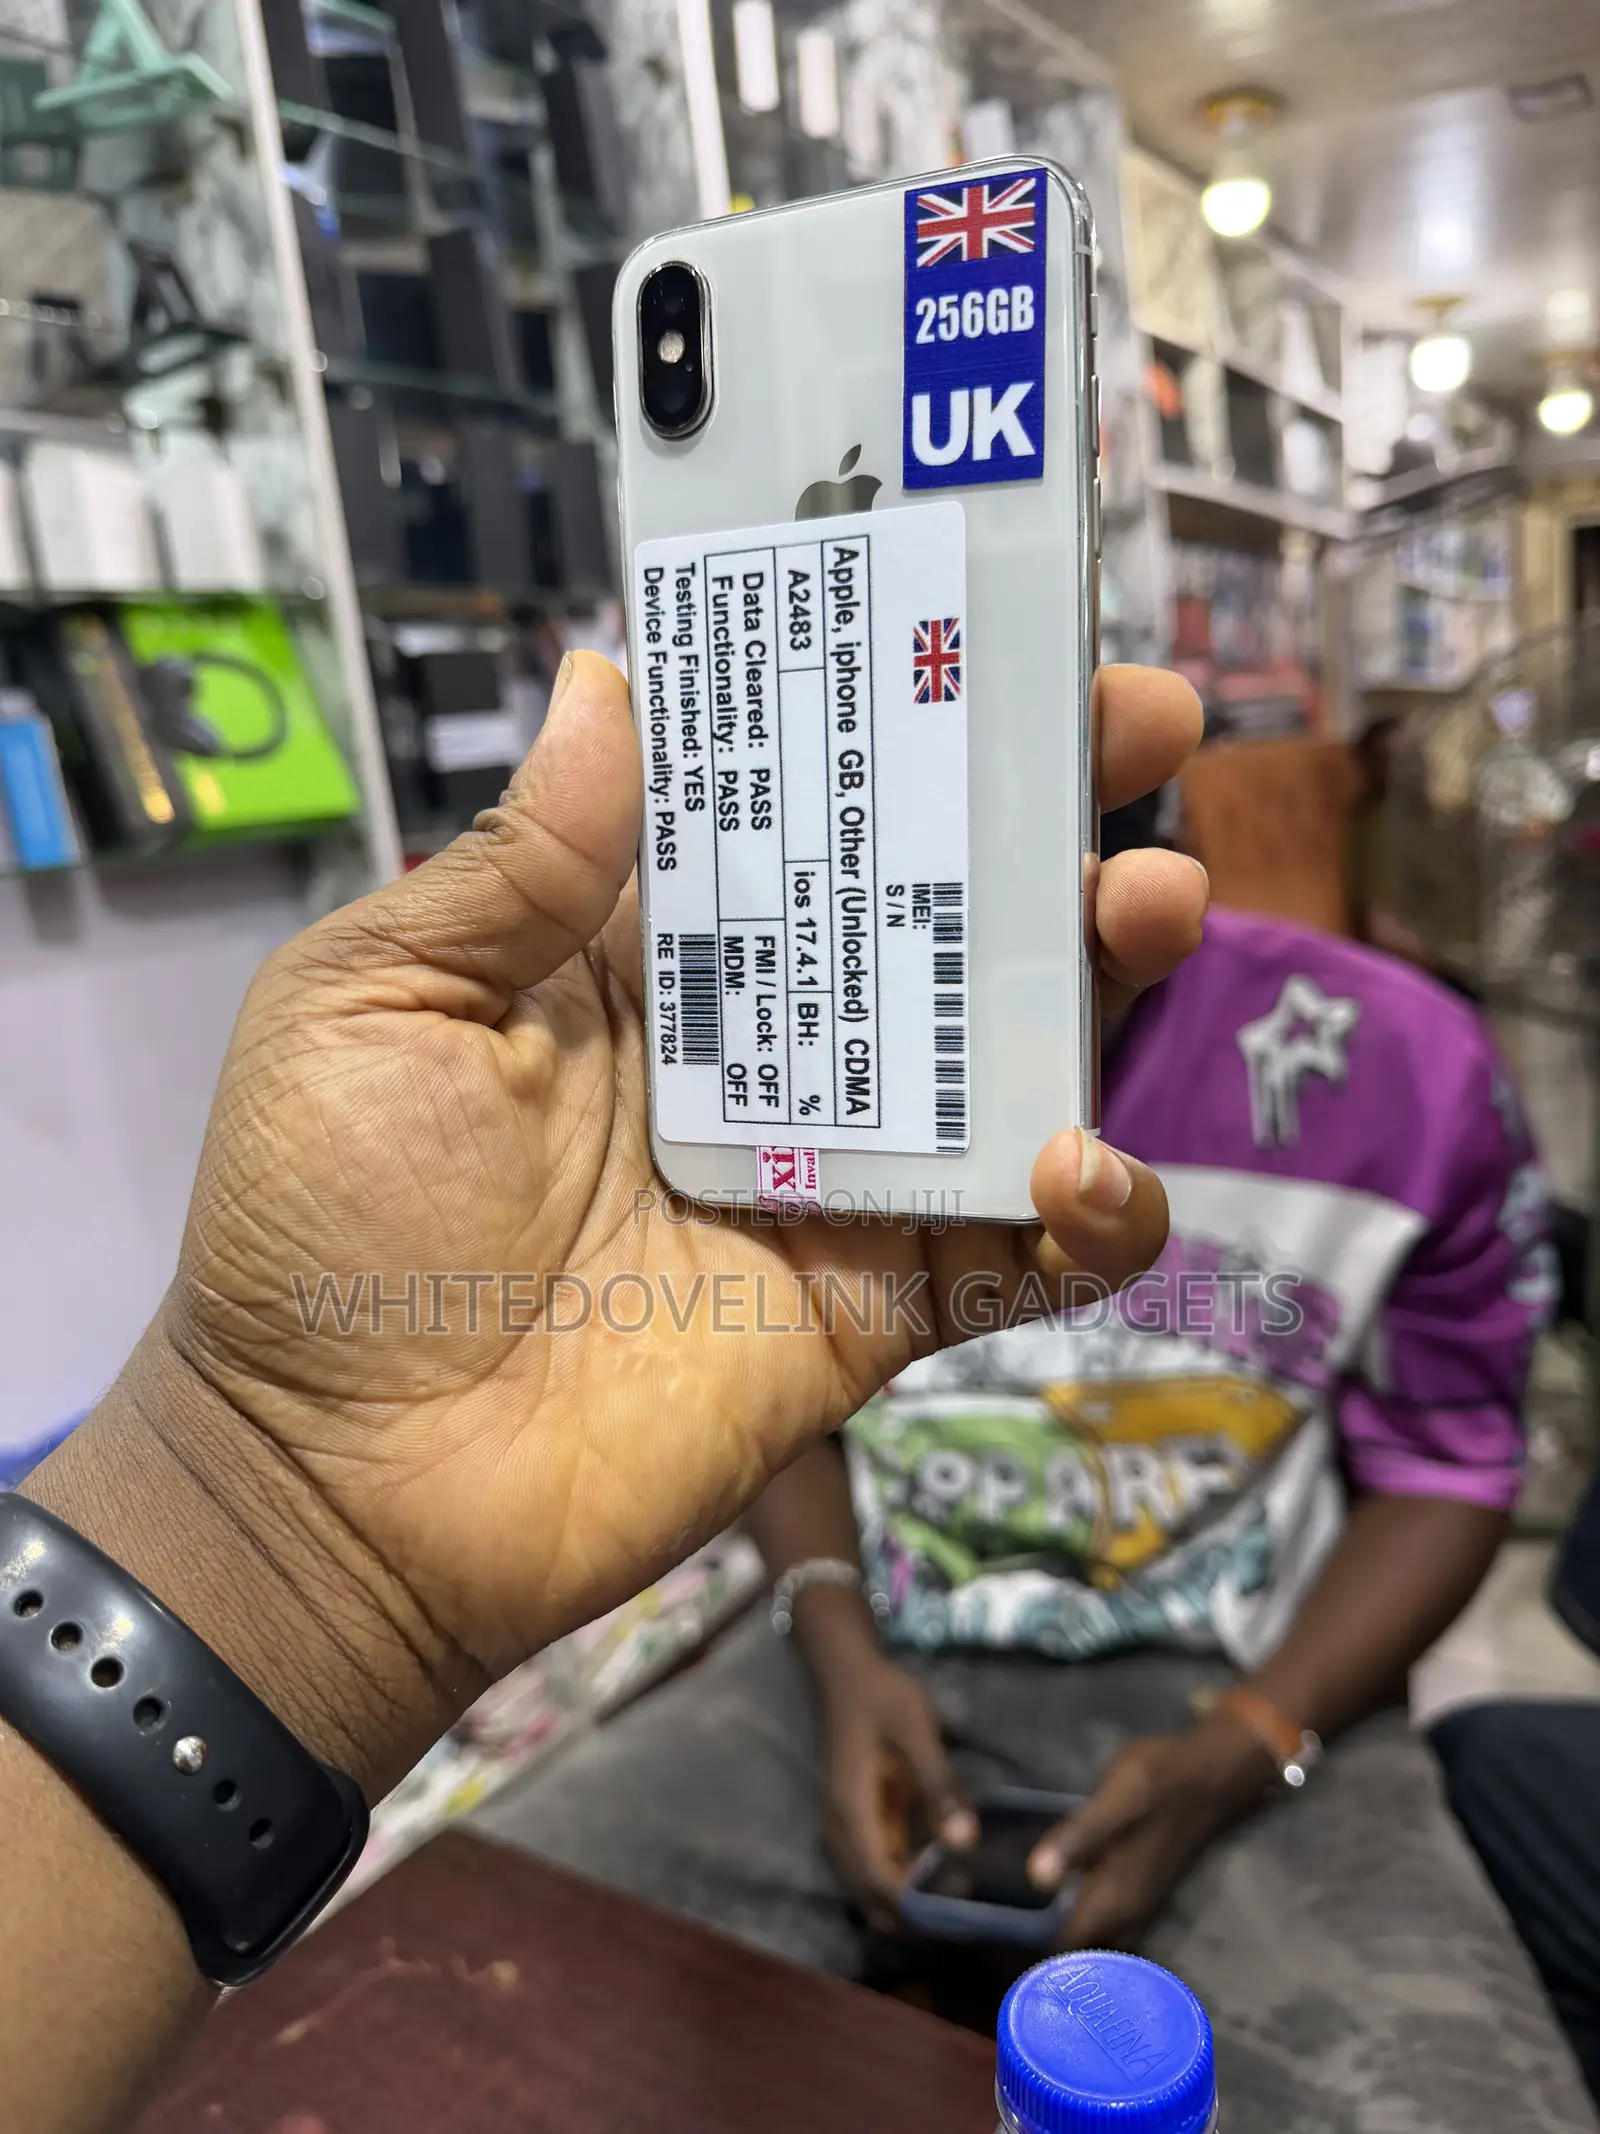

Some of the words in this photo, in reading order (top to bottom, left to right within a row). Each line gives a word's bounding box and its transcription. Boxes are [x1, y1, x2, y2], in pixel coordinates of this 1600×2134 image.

[915, 285, 1035, 345] 256GB
[911, 381, 1036, 467] UK
[643, 567, 666, 644] Device
[671, 561, 697, 649] Testing
[742, 571, 764, 632] Data
[787, 569, 812, 651] A2483
[827, 546, 861, 634] Apple,
[711, 575, 738, 753] Functionality:
[744, 639, 769, 749] Cleared:
[829, 641, 862, 733] iphone
[647, 651, 673, 804] Functionality:
[678, 654, 703, 759] Finished:
[683, 765, 706, 813] YES
[716, 770, 741, 832] PASS
[749, 768, 773, 831] PASS
[834, 748, 865, 798] GB,
[655, 811, 678, 872] PASS
[839, 806, 866, 880] Other
[793, 871, 816, 909] ios
[911, 882, 932, 930] IMEI:
[657, 932, 675, 960] RE
[723, 935, 746, 996] MDM:
[754, 935, 777, 974] FMI
[795, 917, 819, 986] 17.4.1
[834, 886, 869, 1023] (Unlocked)
[658, 970, 676, 995] ID:
[659, 1001, 678, 1066] 377824
[755, 994, 778, 1053] Lock:
[797, 1002, 820, 1047] BH:
[726, 1062, 748, 1107] OFF
[757, 1063, 780, 1108] OFF
[798, 1094, 821, 1116] %
[844, 1038, 871, 1116] CDMA
[1047, 1963, 1175, 2079] AQUAFINA
